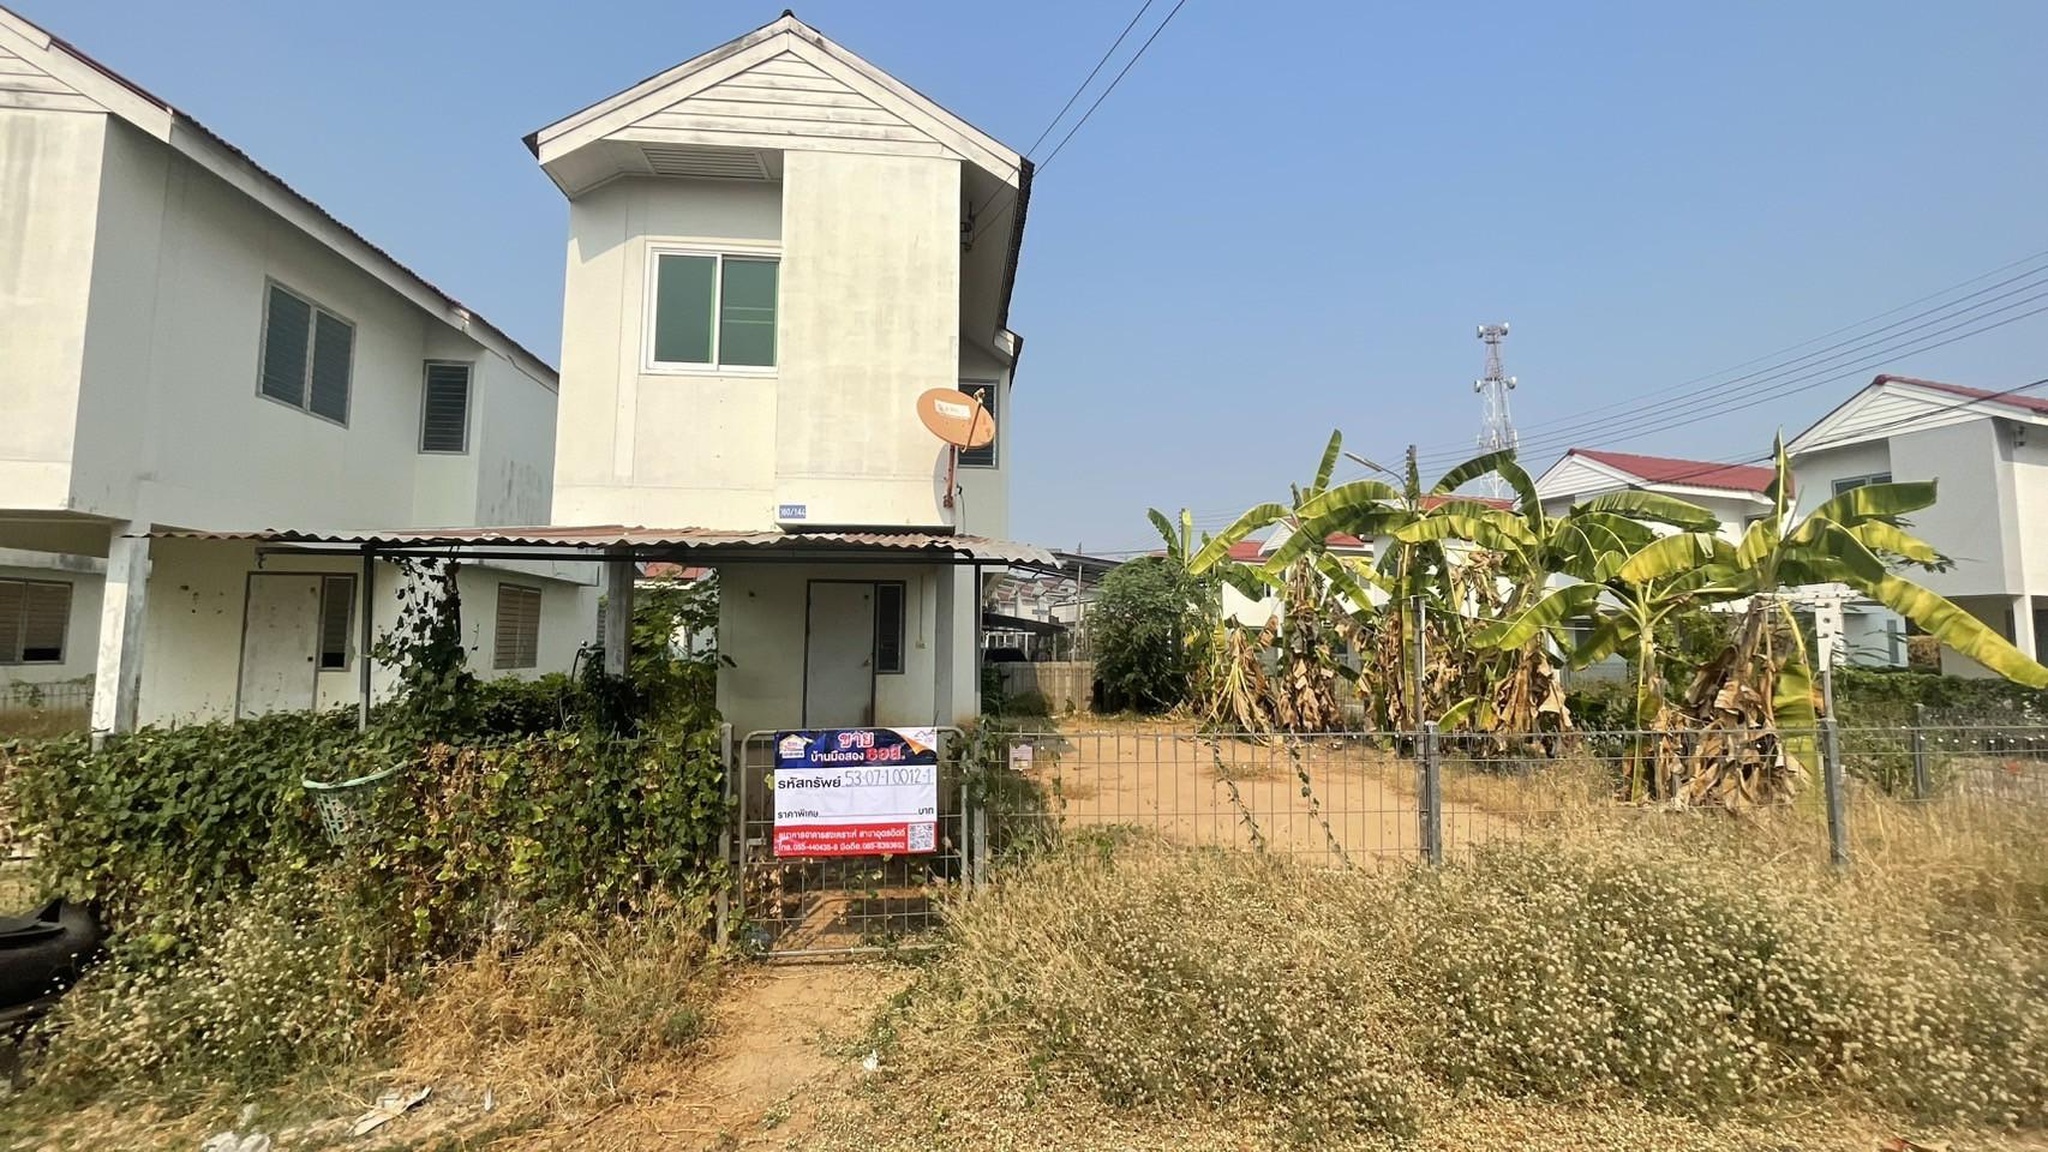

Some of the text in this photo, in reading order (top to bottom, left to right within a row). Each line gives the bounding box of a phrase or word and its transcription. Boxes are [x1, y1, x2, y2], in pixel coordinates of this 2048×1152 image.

[838, 731, 874, 748] ขาย
[811, 750, 864, 762] บ้านมือสอง
[778, 775, 841, 789] รหัสทรัพย์
[918, 807, 934, 815] บาท
